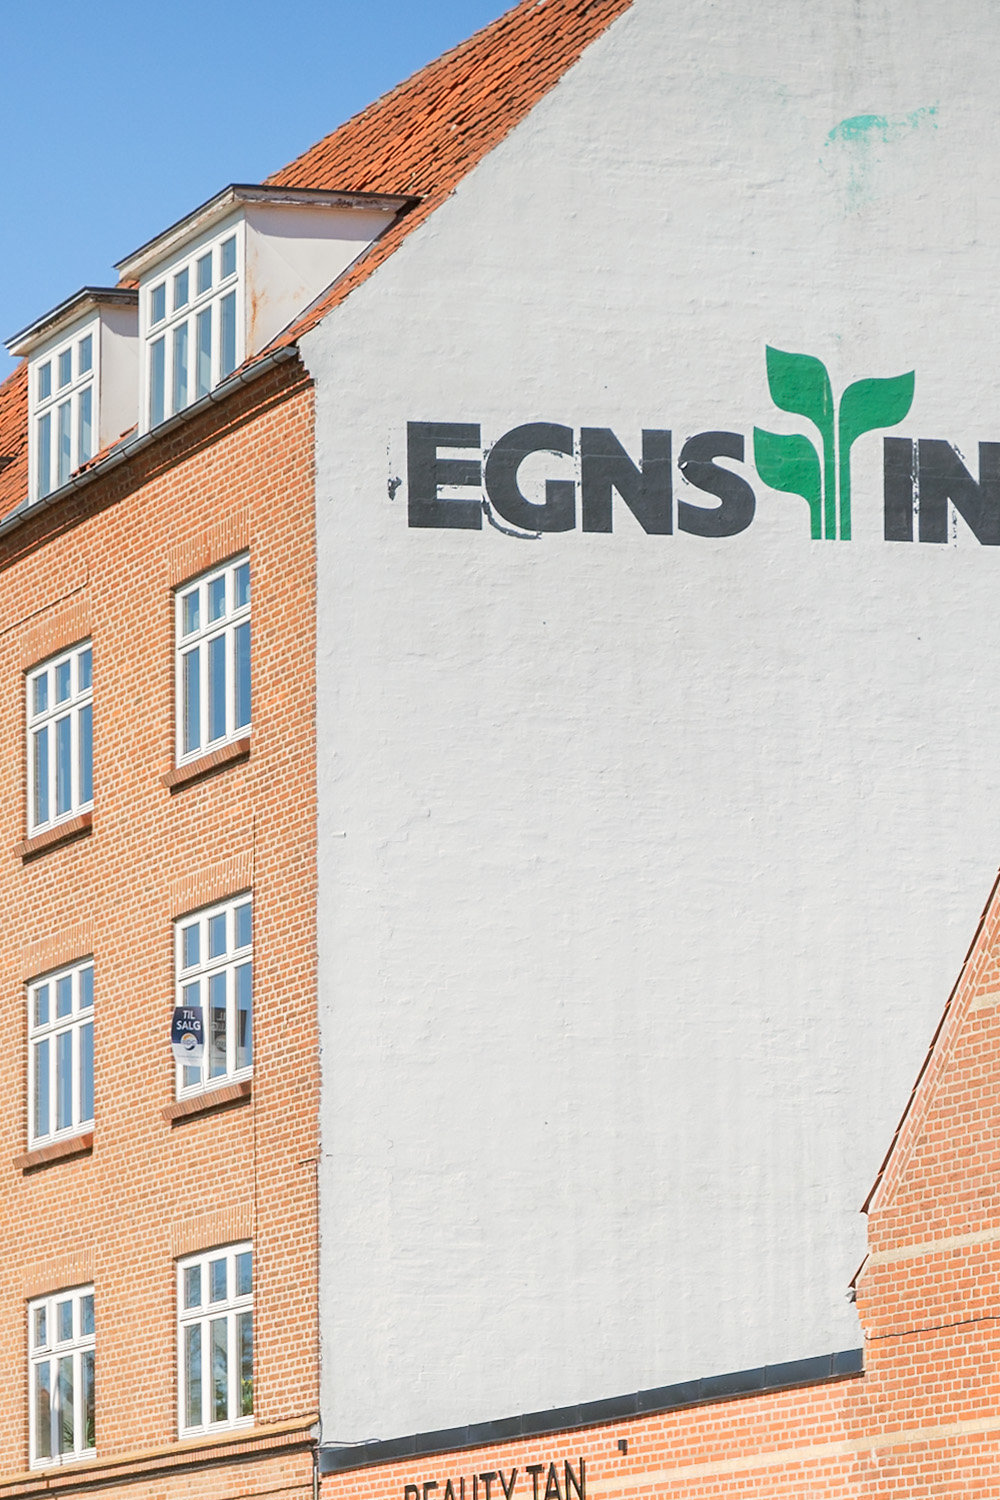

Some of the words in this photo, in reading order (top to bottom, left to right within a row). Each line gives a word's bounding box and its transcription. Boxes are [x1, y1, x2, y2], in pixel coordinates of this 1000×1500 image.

[406, 421, 756, 538] EGNS
[883, 436, 1000, 546] IN
[183, 1010, 195, 1019] TIL
[176, 1020, 201, 1031] SALG
